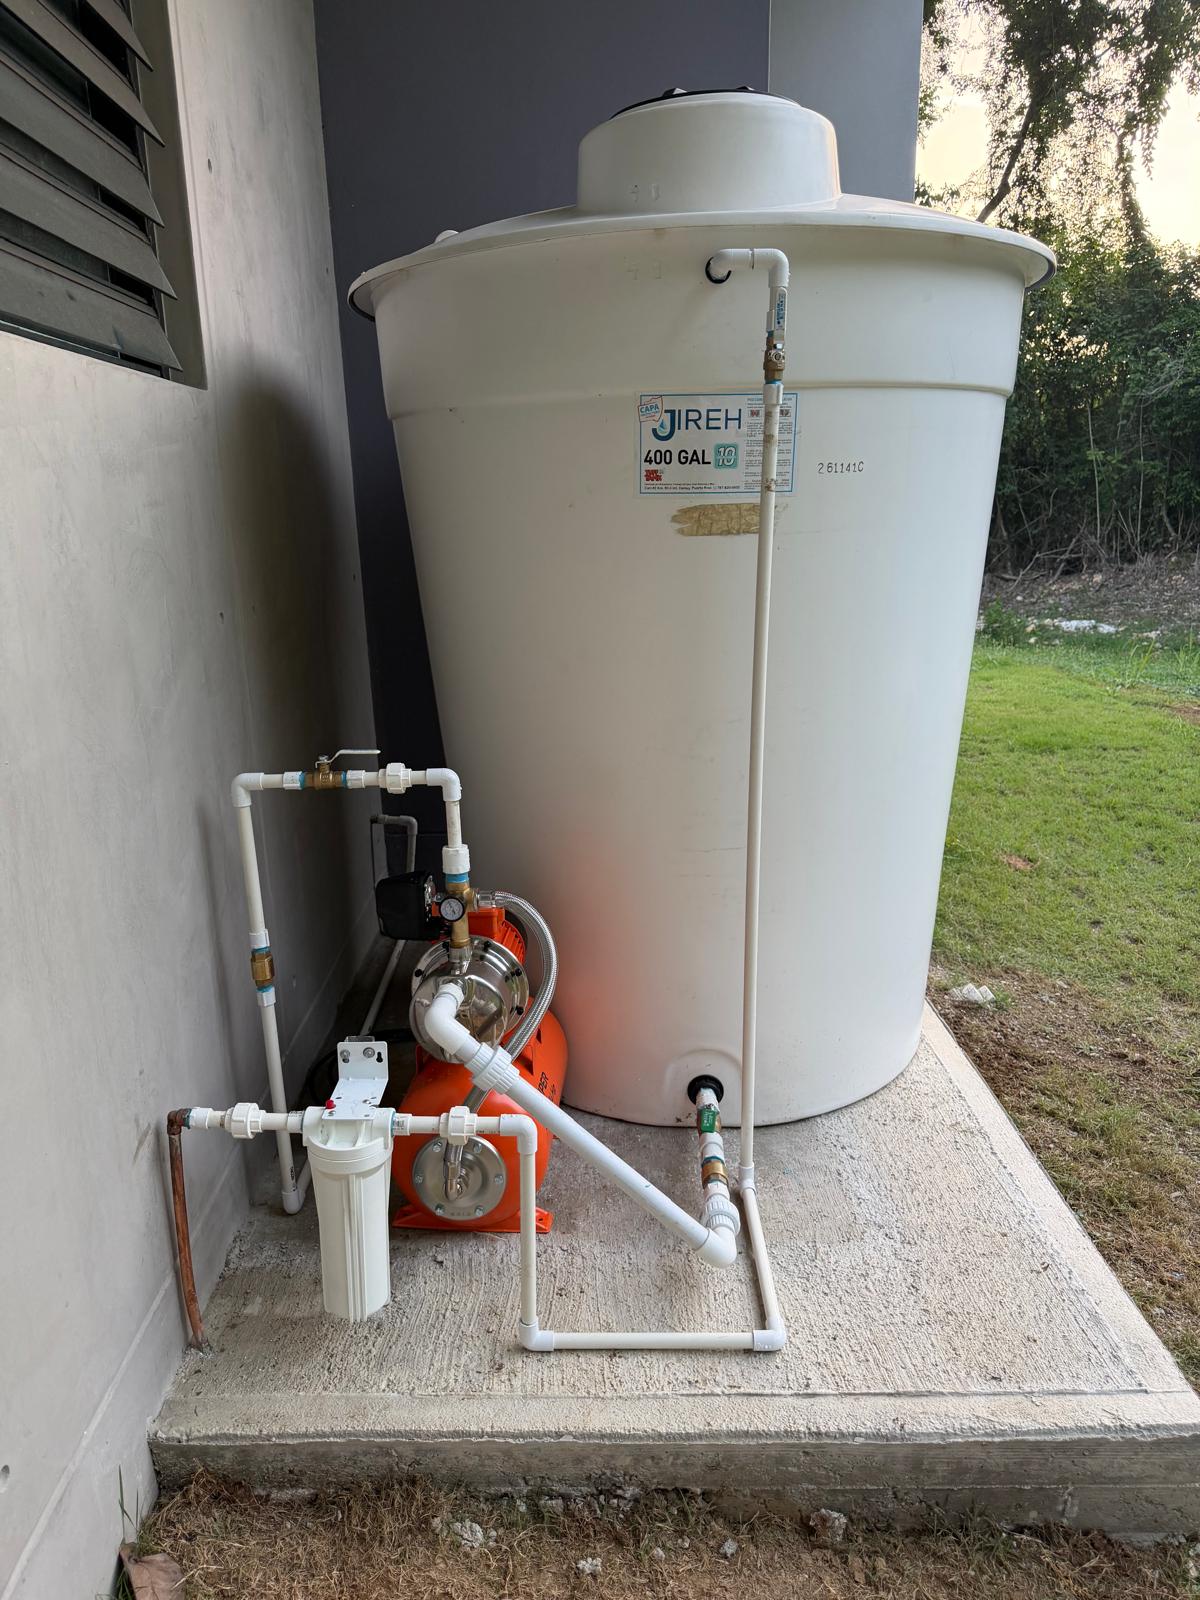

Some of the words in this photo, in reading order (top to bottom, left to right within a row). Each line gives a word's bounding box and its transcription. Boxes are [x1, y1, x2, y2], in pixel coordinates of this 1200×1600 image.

[640, 403, 660, 413] CAPA
[652, 409, 742, 441] JIREH
[644, 449, 673, 465] 400
[678, 449, 711, 465] GAL
[717, 446, 736, 467] 10
